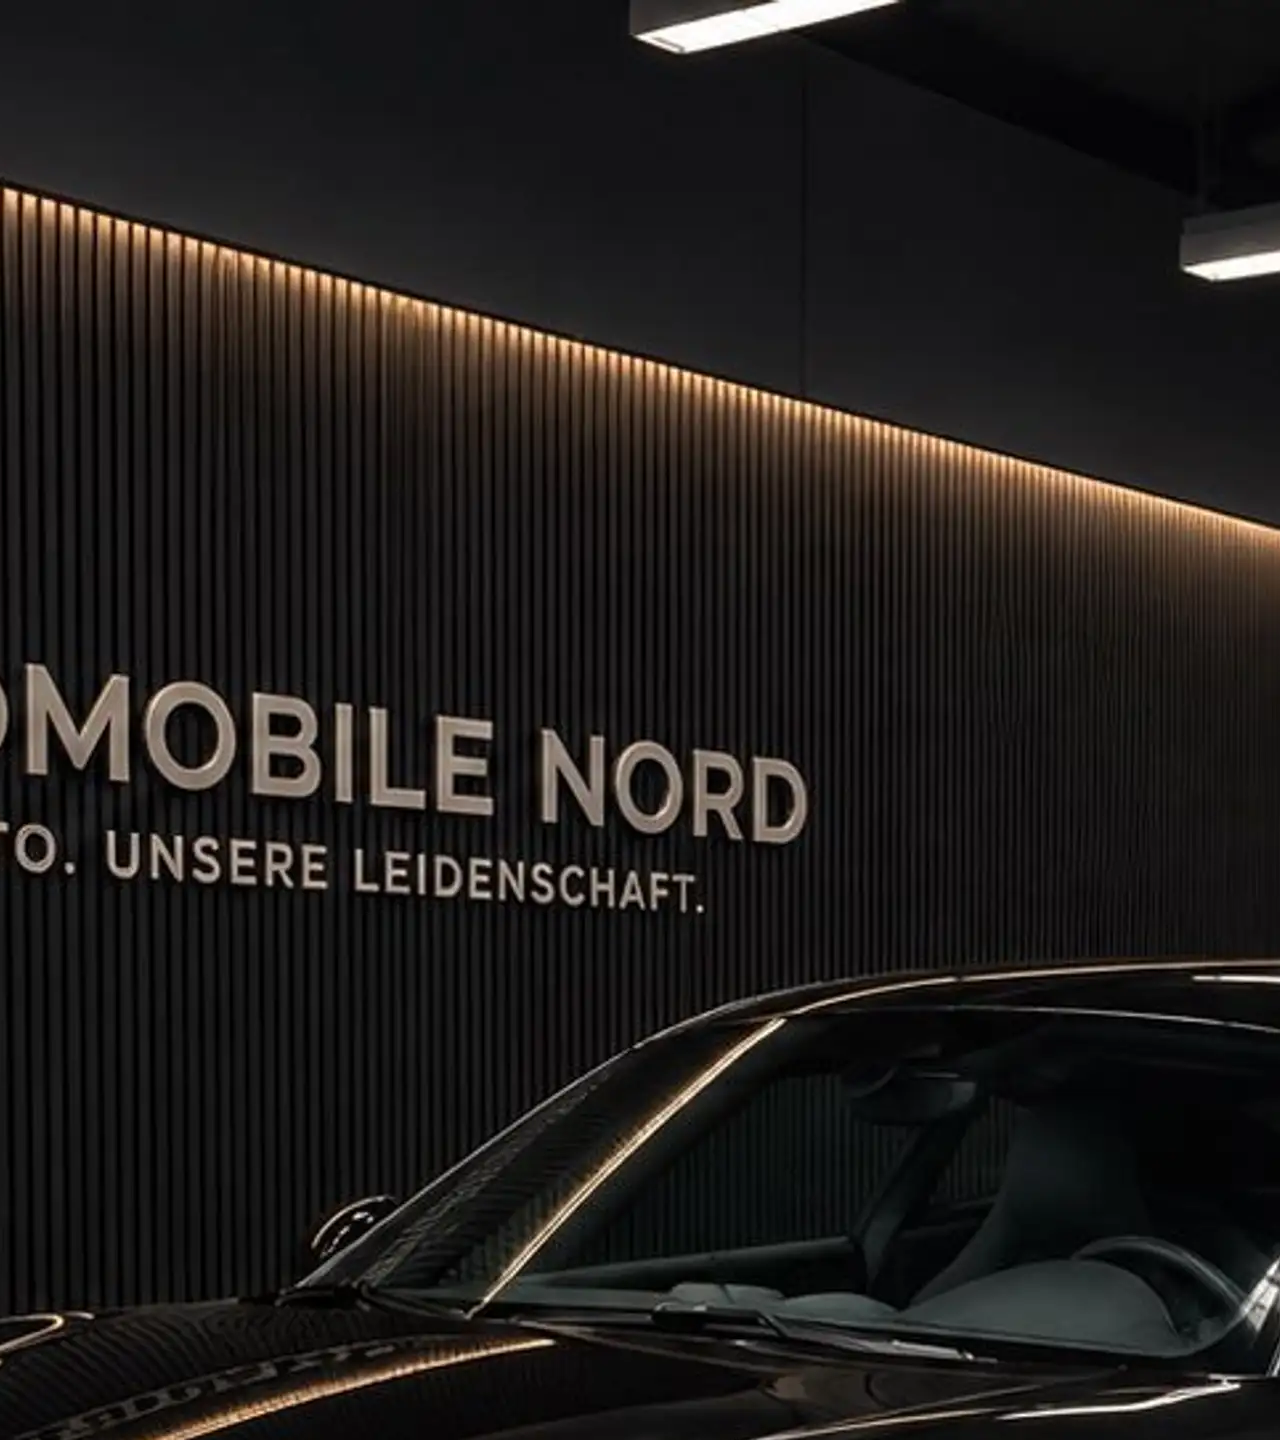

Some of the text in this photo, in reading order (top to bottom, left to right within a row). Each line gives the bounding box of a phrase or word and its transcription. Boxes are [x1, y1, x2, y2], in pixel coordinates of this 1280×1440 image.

[540, 727, 808, 845] NORD
[105, 828, 330, 891] UNSERE
[353, 847, 705, 914] LEIDENSCHAFT.
